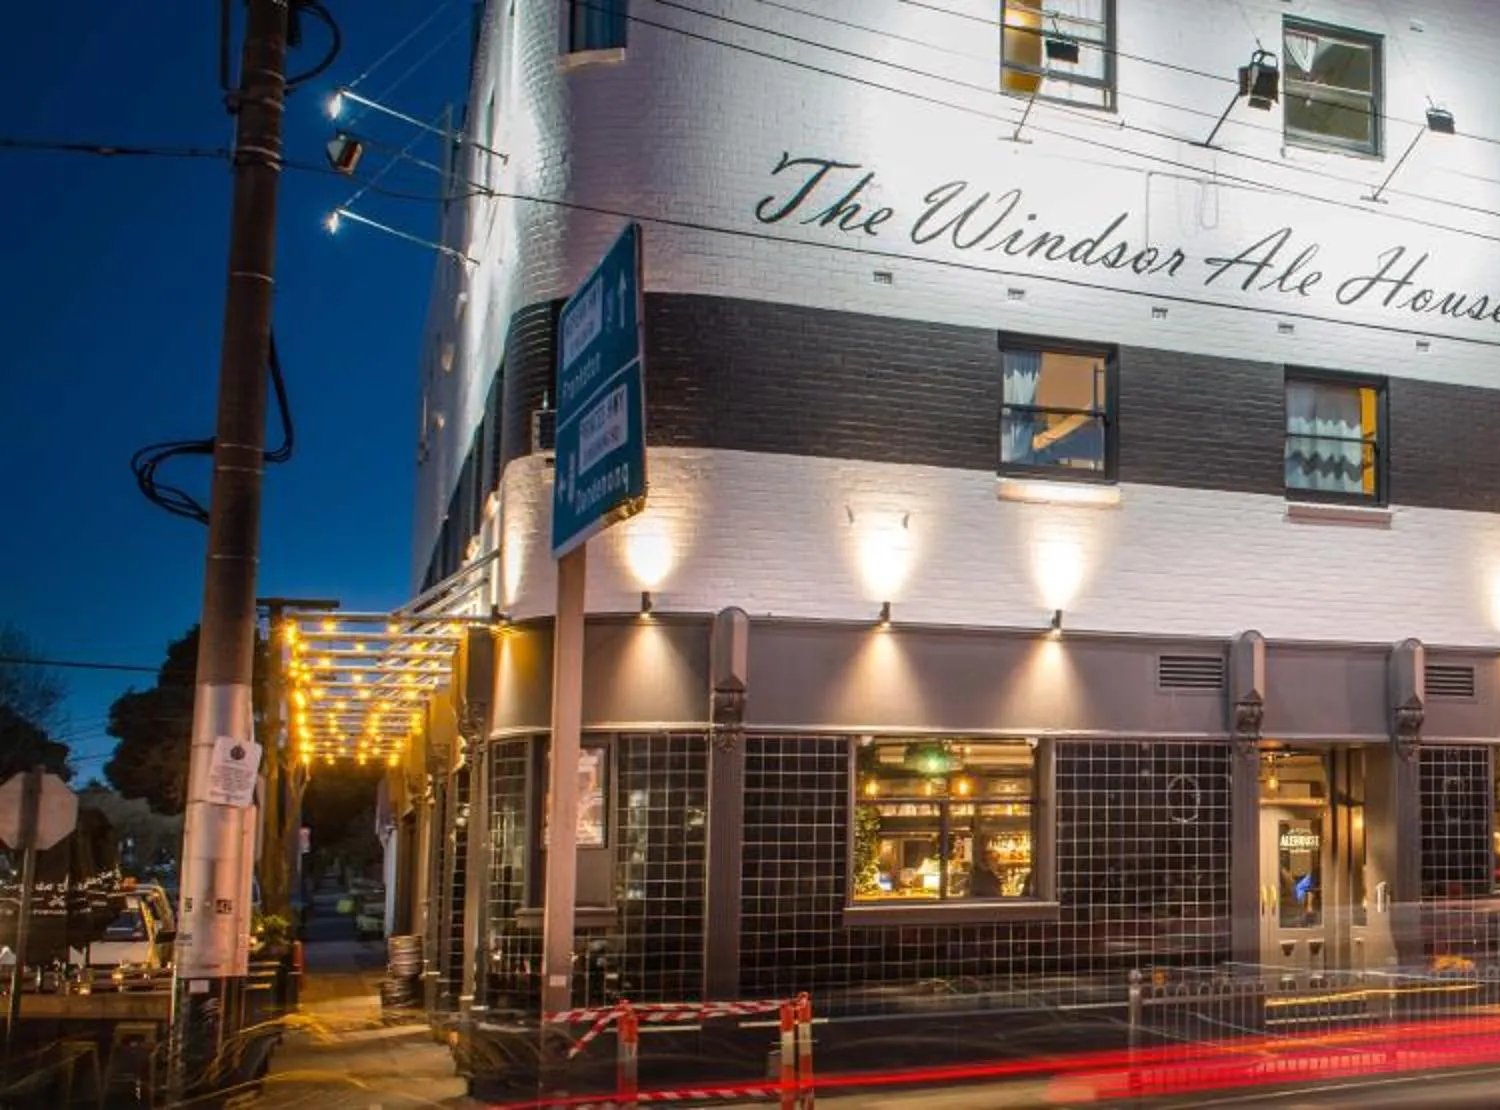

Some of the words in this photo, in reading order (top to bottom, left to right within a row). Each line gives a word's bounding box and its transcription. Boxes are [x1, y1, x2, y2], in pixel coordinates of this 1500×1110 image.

[755, 152, 894, 236] The
[911, 180, 1185, 278] Windsor
[1204, 227, 1323, 297] Ale
